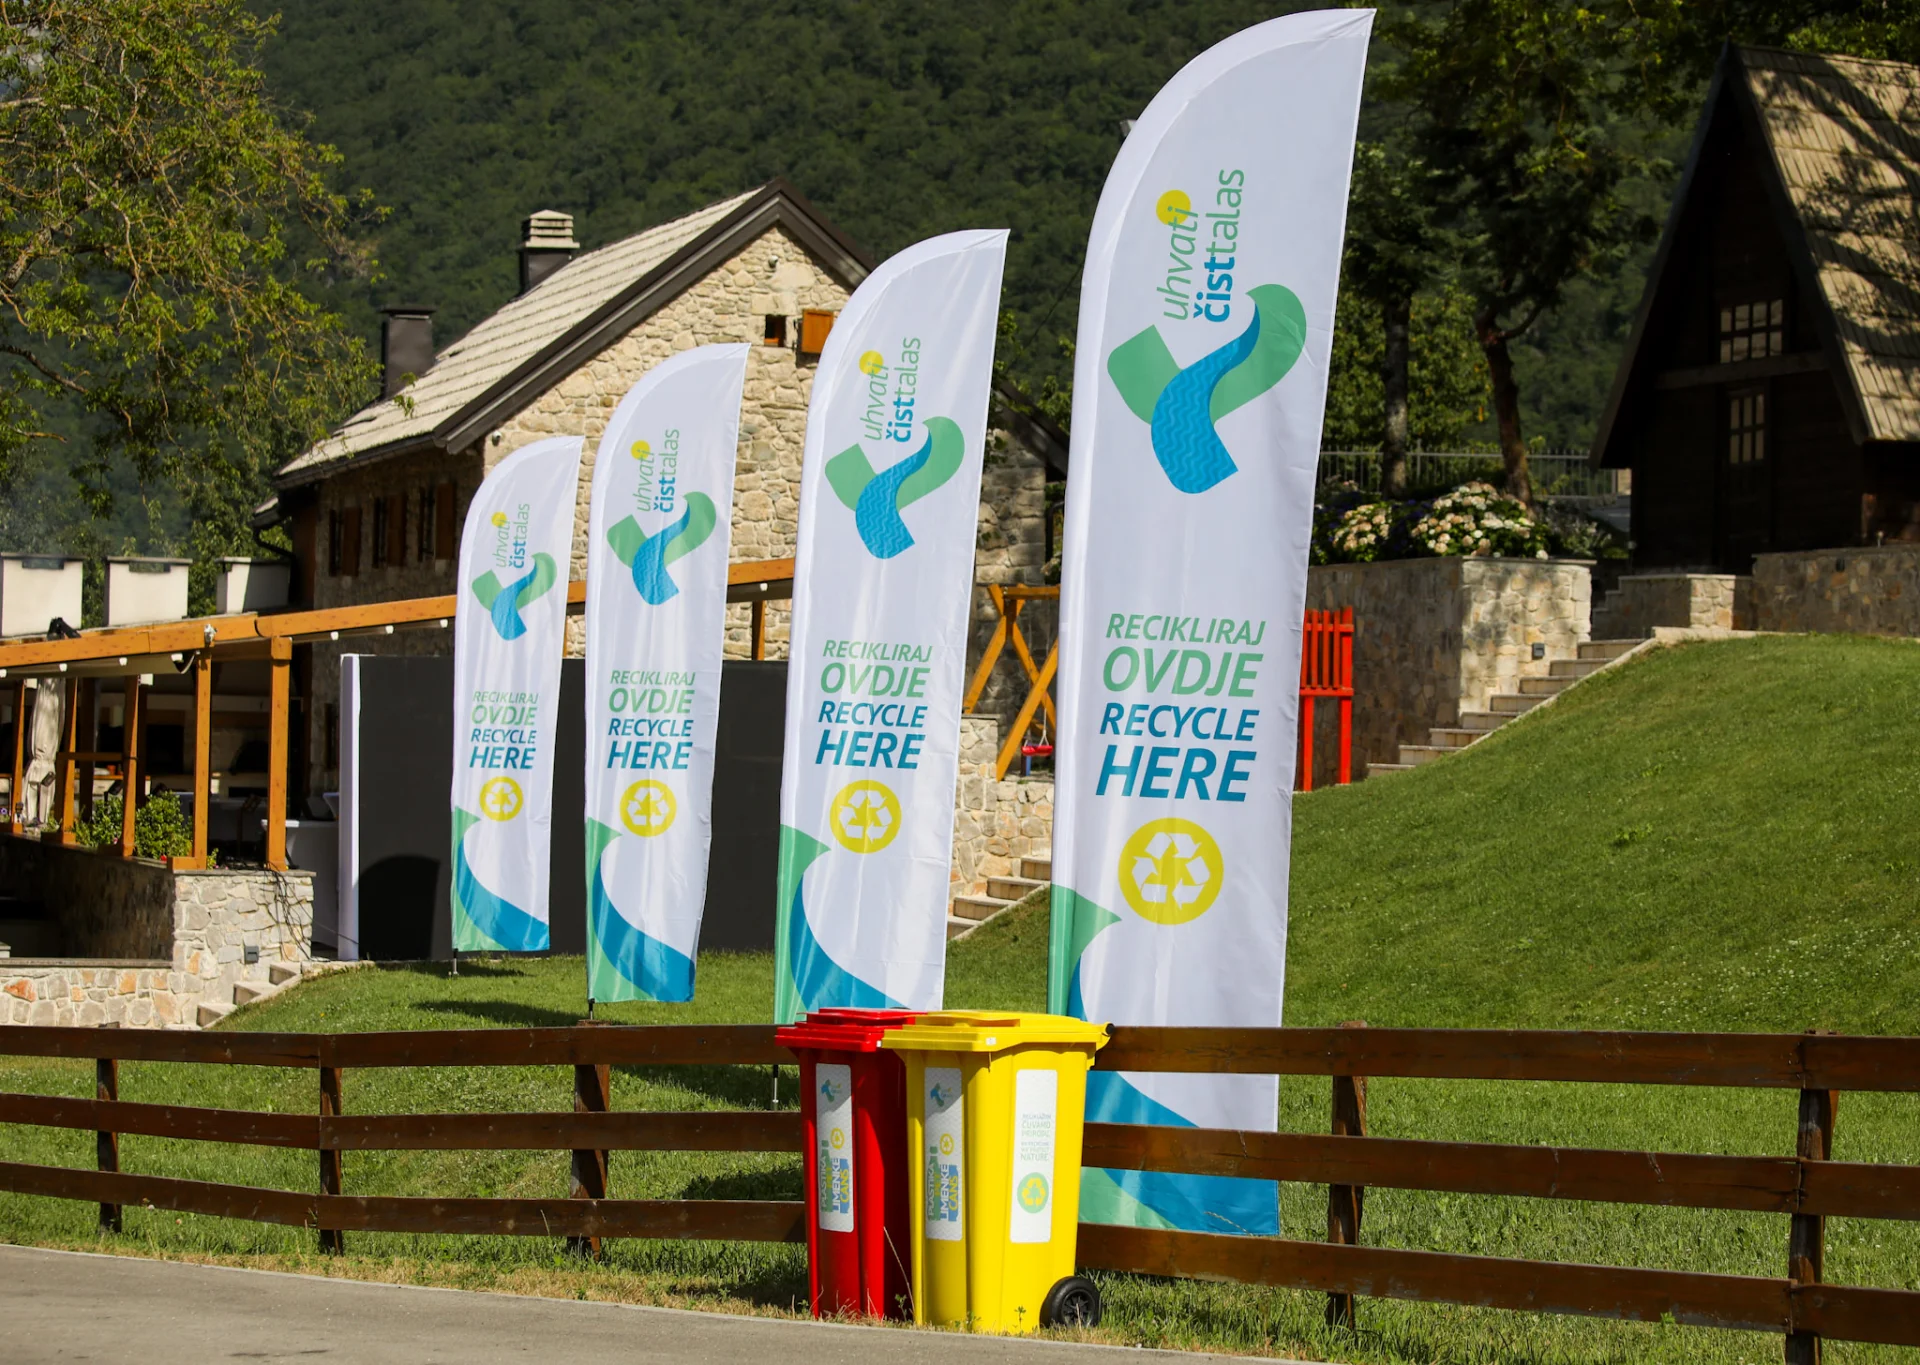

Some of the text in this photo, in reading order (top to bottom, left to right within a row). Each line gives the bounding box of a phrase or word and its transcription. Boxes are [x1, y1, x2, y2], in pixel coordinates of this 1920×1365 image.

[1156, 206, 1199, 320] uhvati
[860, 362, 889, 440] uhvati
[632, 449, 655, 512] uhvati
[1106, 613, 1266, 645] RECIKLIRAJ
[823, 640, 933, 662] RECIKLIRAJ
[610, 670, 696, 685] RECIKLIRAJ
[820, 662, 931, 698] OVDJE
[1103, 646, 1264, 697] OVDJE
[472, 691, 539, 704] RECIKLIRAJ
[608, 687, 695, 714] OVDJE
[818, 701, 928, 728] RECYCLE
[471, 705, 538, 726] OVDJE
[608, 718, 694, 737] RECYCLE
[1100, 702, 1260, 741] RECYCLE
[470, 728, 537, 744] RECYCLE
[815, 729, 926, 770] HERE
[469, 746, 536, 770] HERE
[607, 740, 693, 770] HERE
[1096, 745, 1257, 802] HERE
[832, 1157, 841, 1212] LIMENKE
[840, 1168, 849, 1204] CANS
[927, 1163, 935, 1216] PLASTIKA
[940, 1163, 949, 1221] LIMENKE
[948, 1176, 958, 1211] CANS
